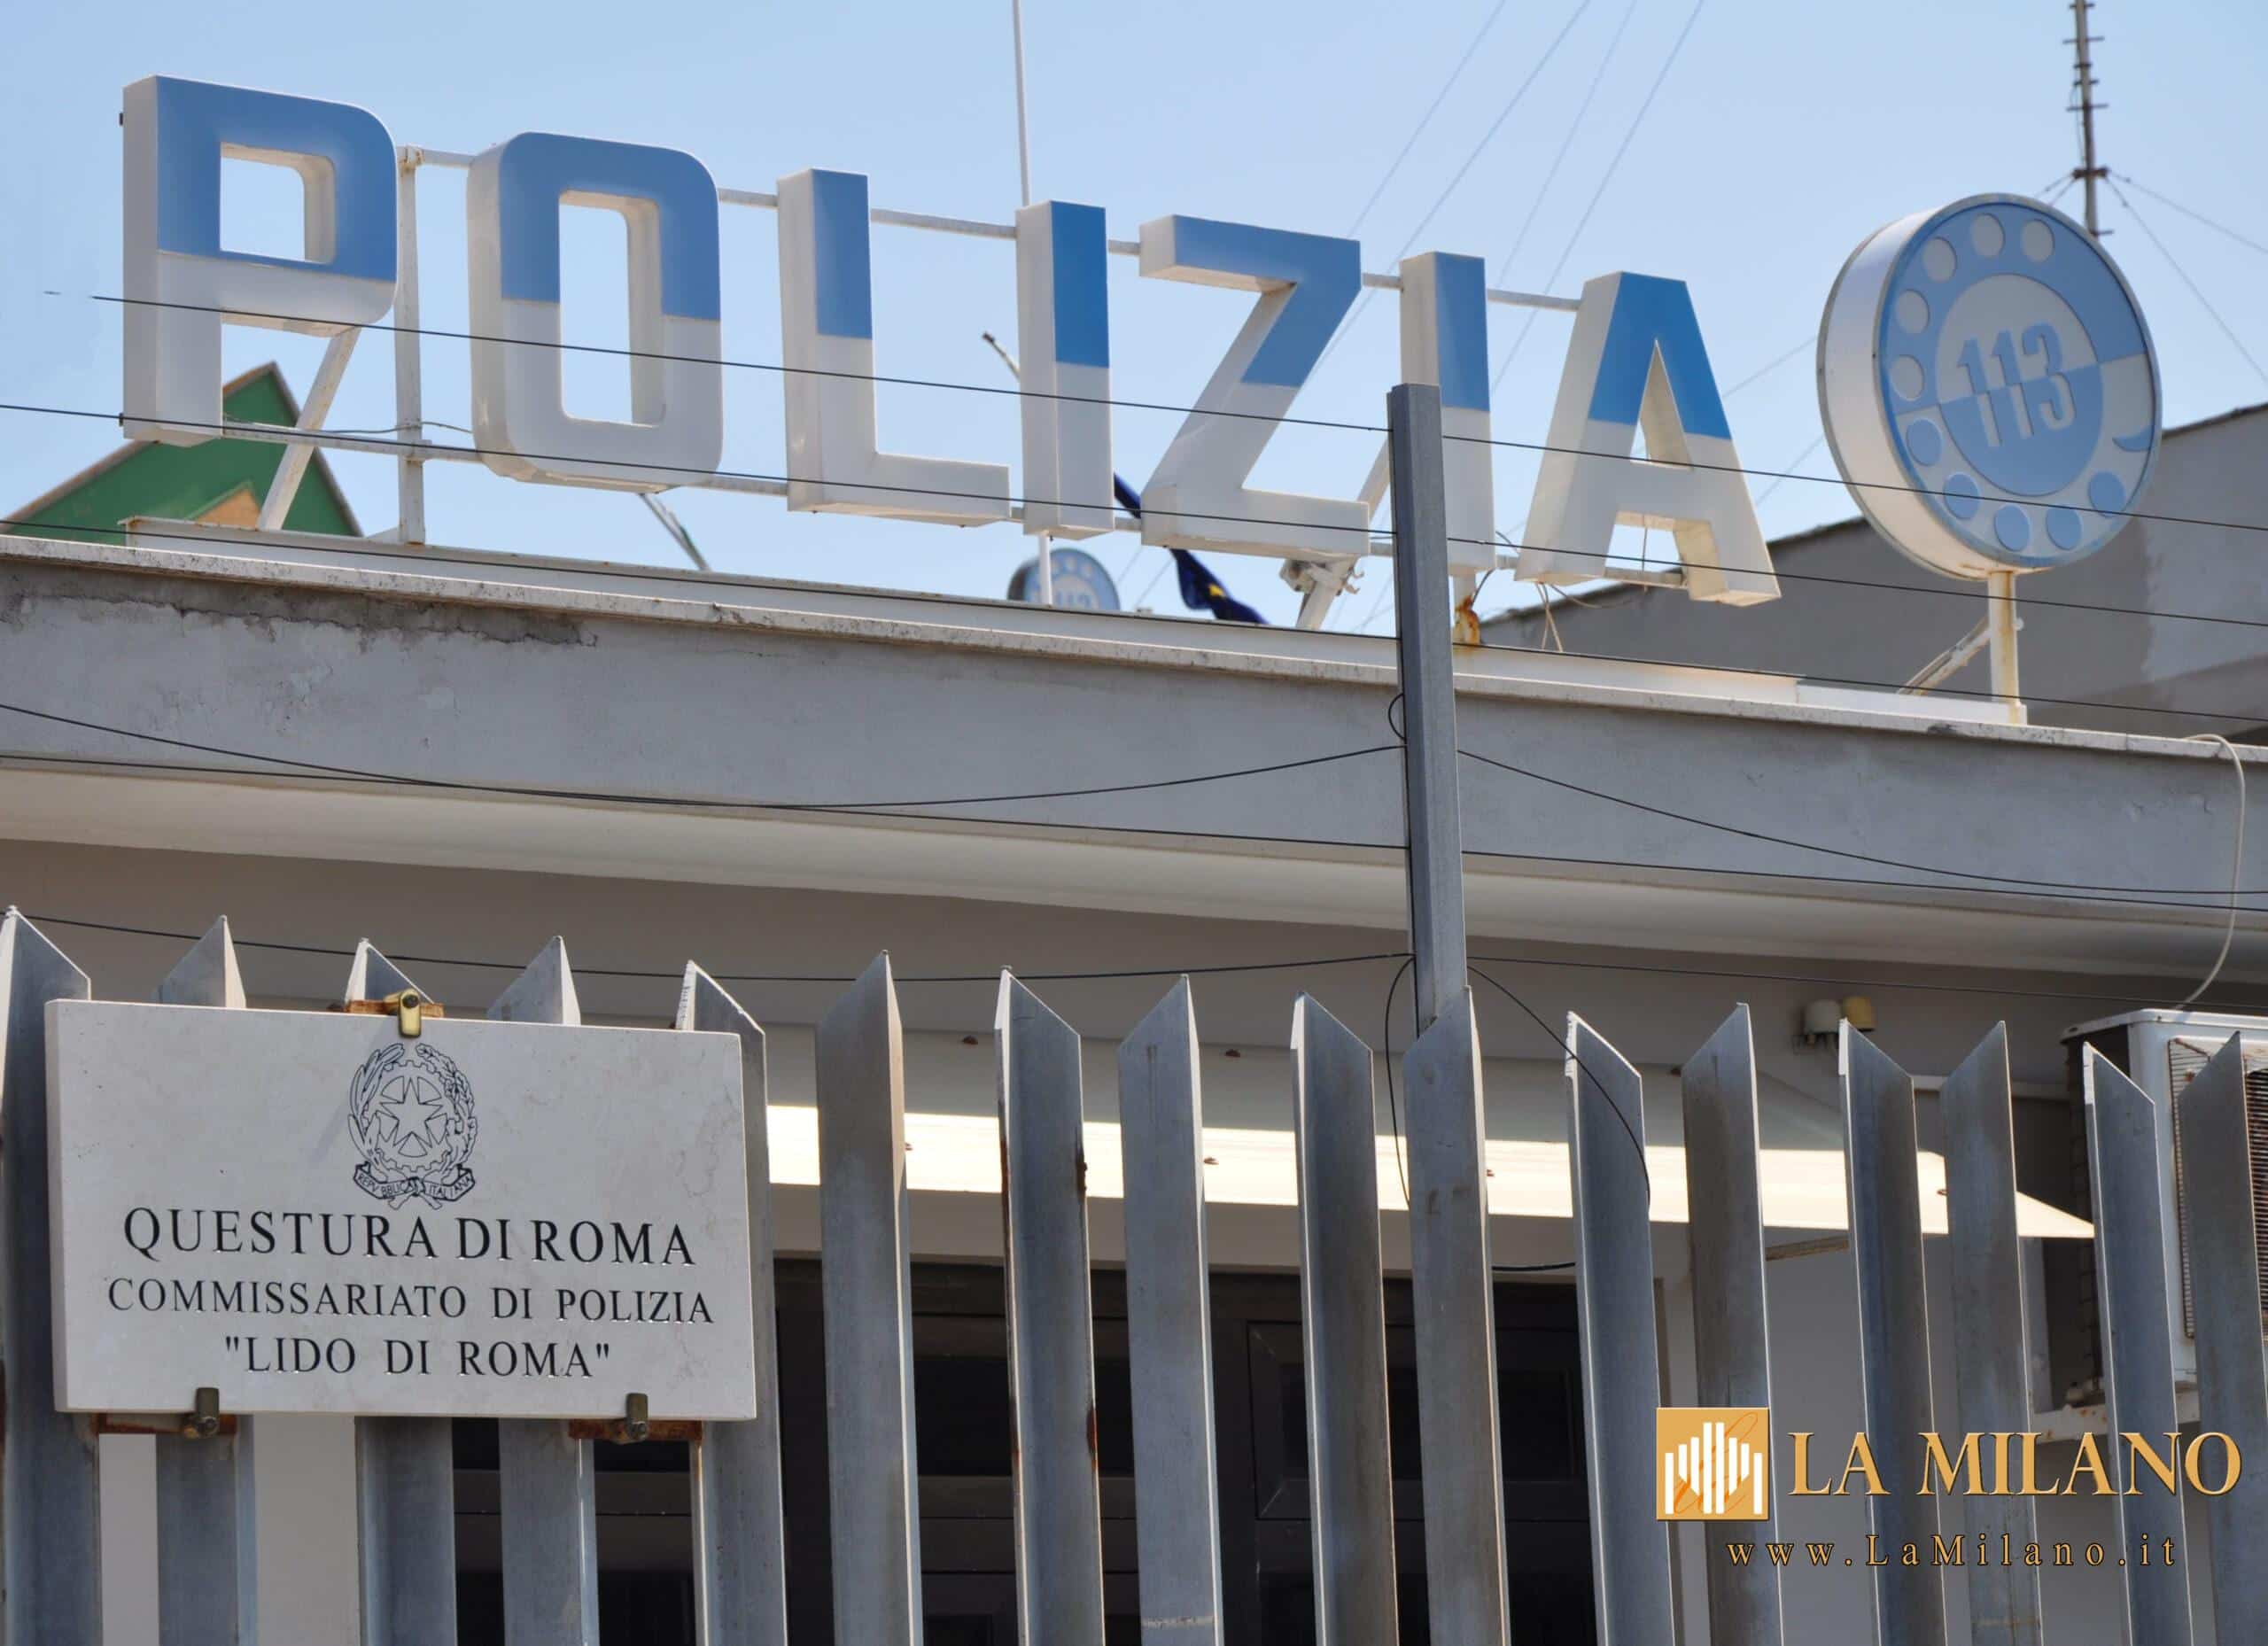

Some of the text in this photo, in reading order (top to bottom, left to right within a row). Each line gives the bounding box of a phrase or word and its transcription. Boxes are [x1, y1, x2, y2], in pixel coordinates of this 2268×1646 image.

[122, 75, 1781, 606] POLIZIA
[1956, 322, 2076, 446] 113
[124, 1207, 695, 1266] QUESTURA DI ROMA
[108, 1277, 714, 1324] COMMISSARIATO DI POLIZIA
[225, 1336, 610, 1378] "LIDO DI ROMA"
